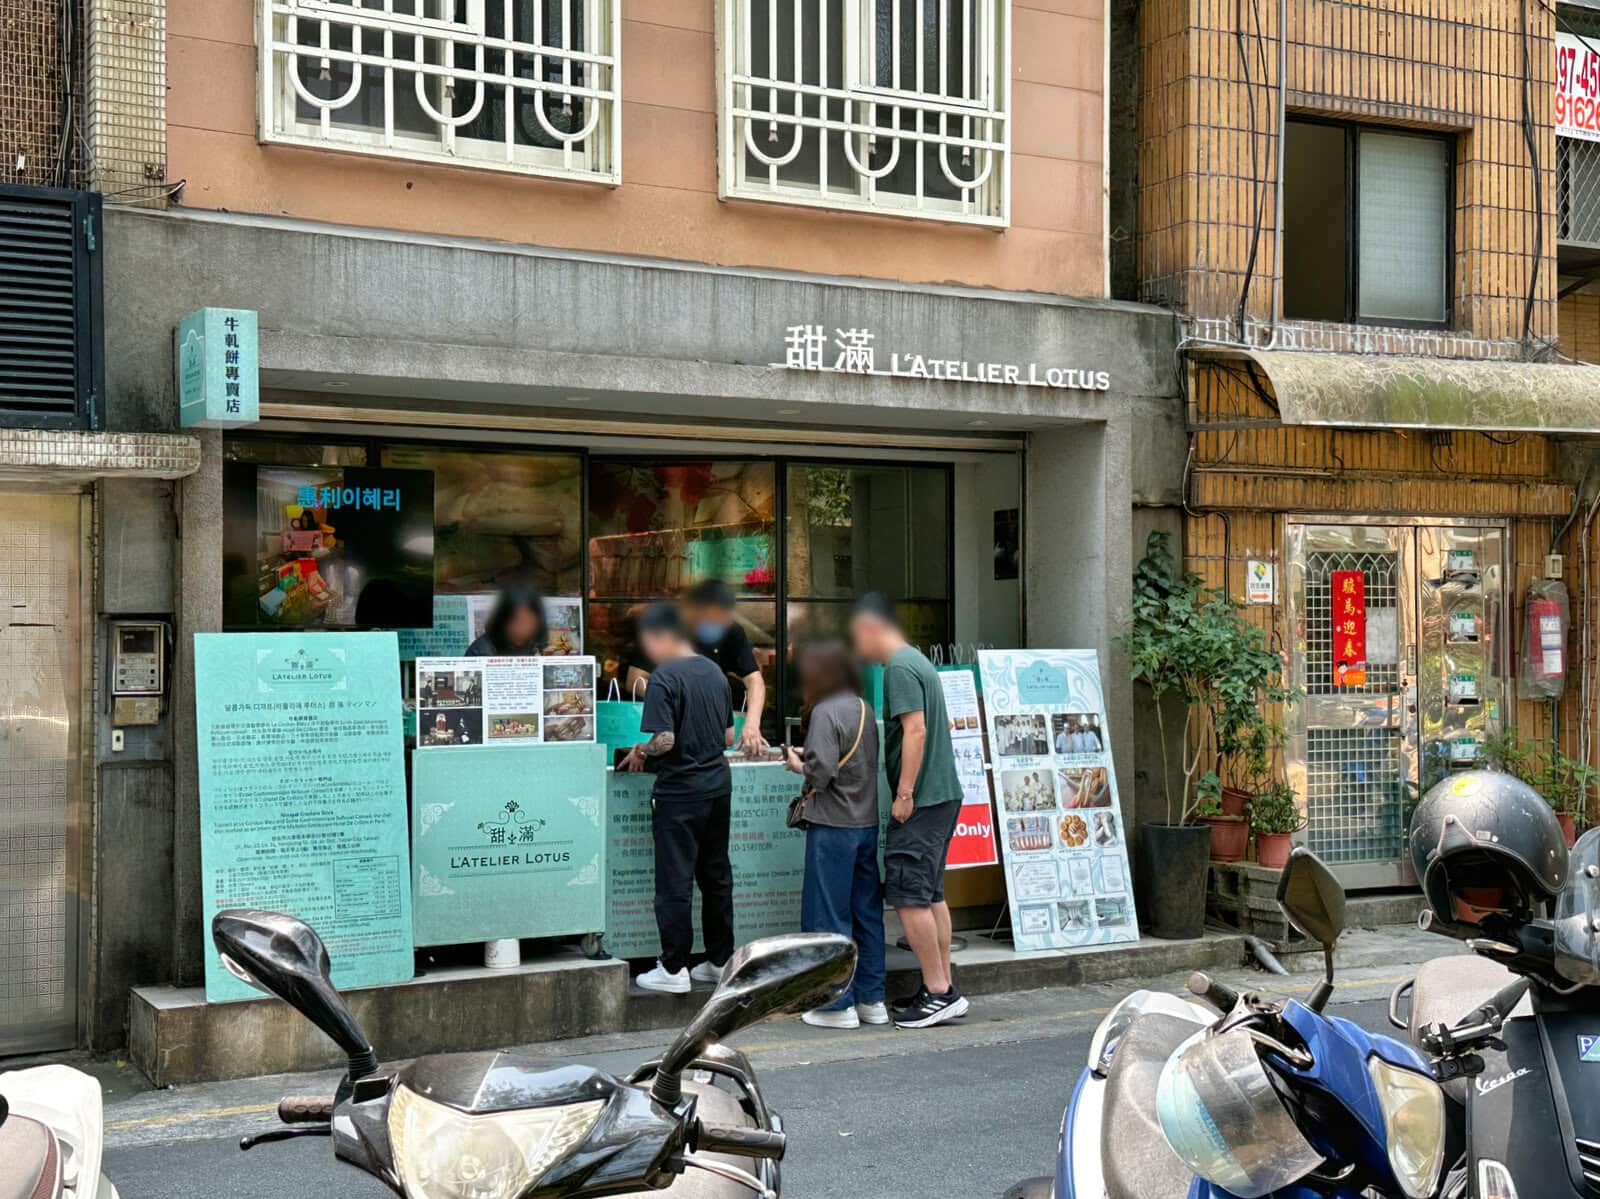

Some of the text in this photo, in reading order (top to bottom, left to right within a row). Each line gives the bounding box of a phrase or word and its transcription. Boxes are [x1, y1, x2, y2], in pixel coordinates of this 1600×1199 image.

[1555, 46, 1600, 97] 97-45
[224, 317, 241, 414] 牛軋餅專賣店
[784, 324, 875, 371] 甜滿
[1028, 363, 1110, 391] LOTUS
[1341, 577, 1358, 658] 駿馬迎春
[490, 826, 535, 844] 甜滿
[956, 821, 991, 839] Only
[525, 852, 571, 864] LOTUS
[1475, 1067, 1534, 1097] Vespa
